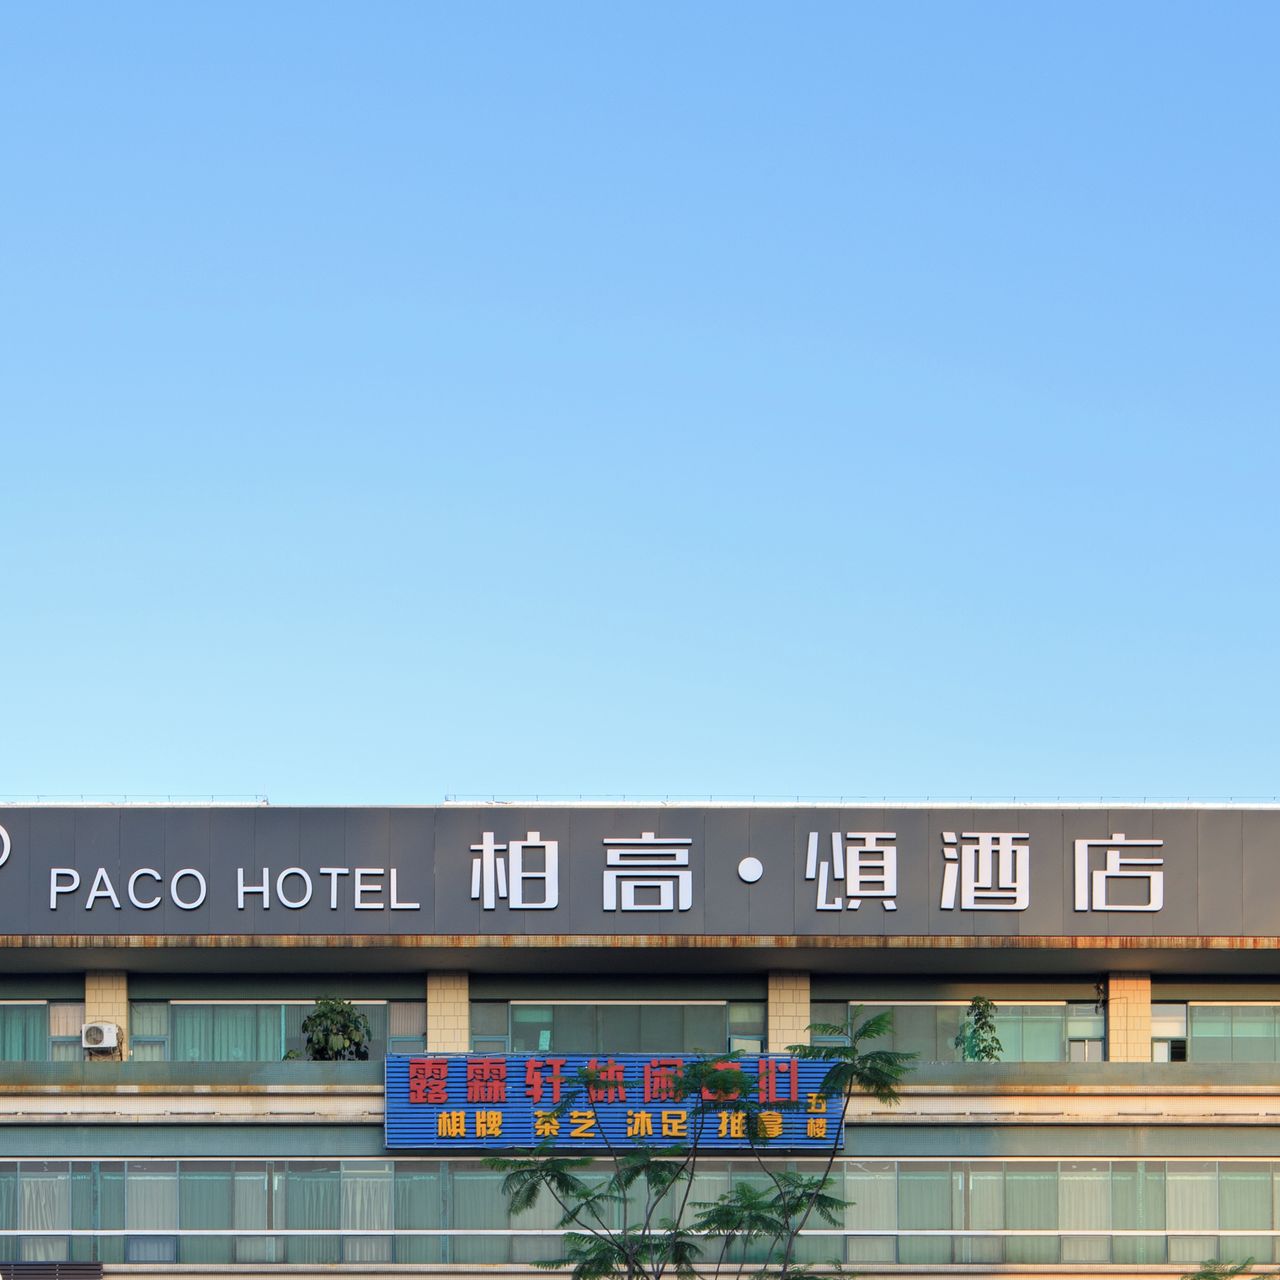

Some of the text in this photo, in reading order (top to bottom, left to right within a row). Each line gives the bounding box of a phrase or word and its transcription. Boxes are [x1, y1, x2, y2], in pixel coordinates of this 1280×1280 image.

[50, 867, 207, 911] PACO
[236, 867, 420, 911] HOTEL
[437, 1110, 503, 1138] 棋牌
[534, 1110, 596, 1138] 茶艺
[626, 1109, 688, 1138] 沐足
